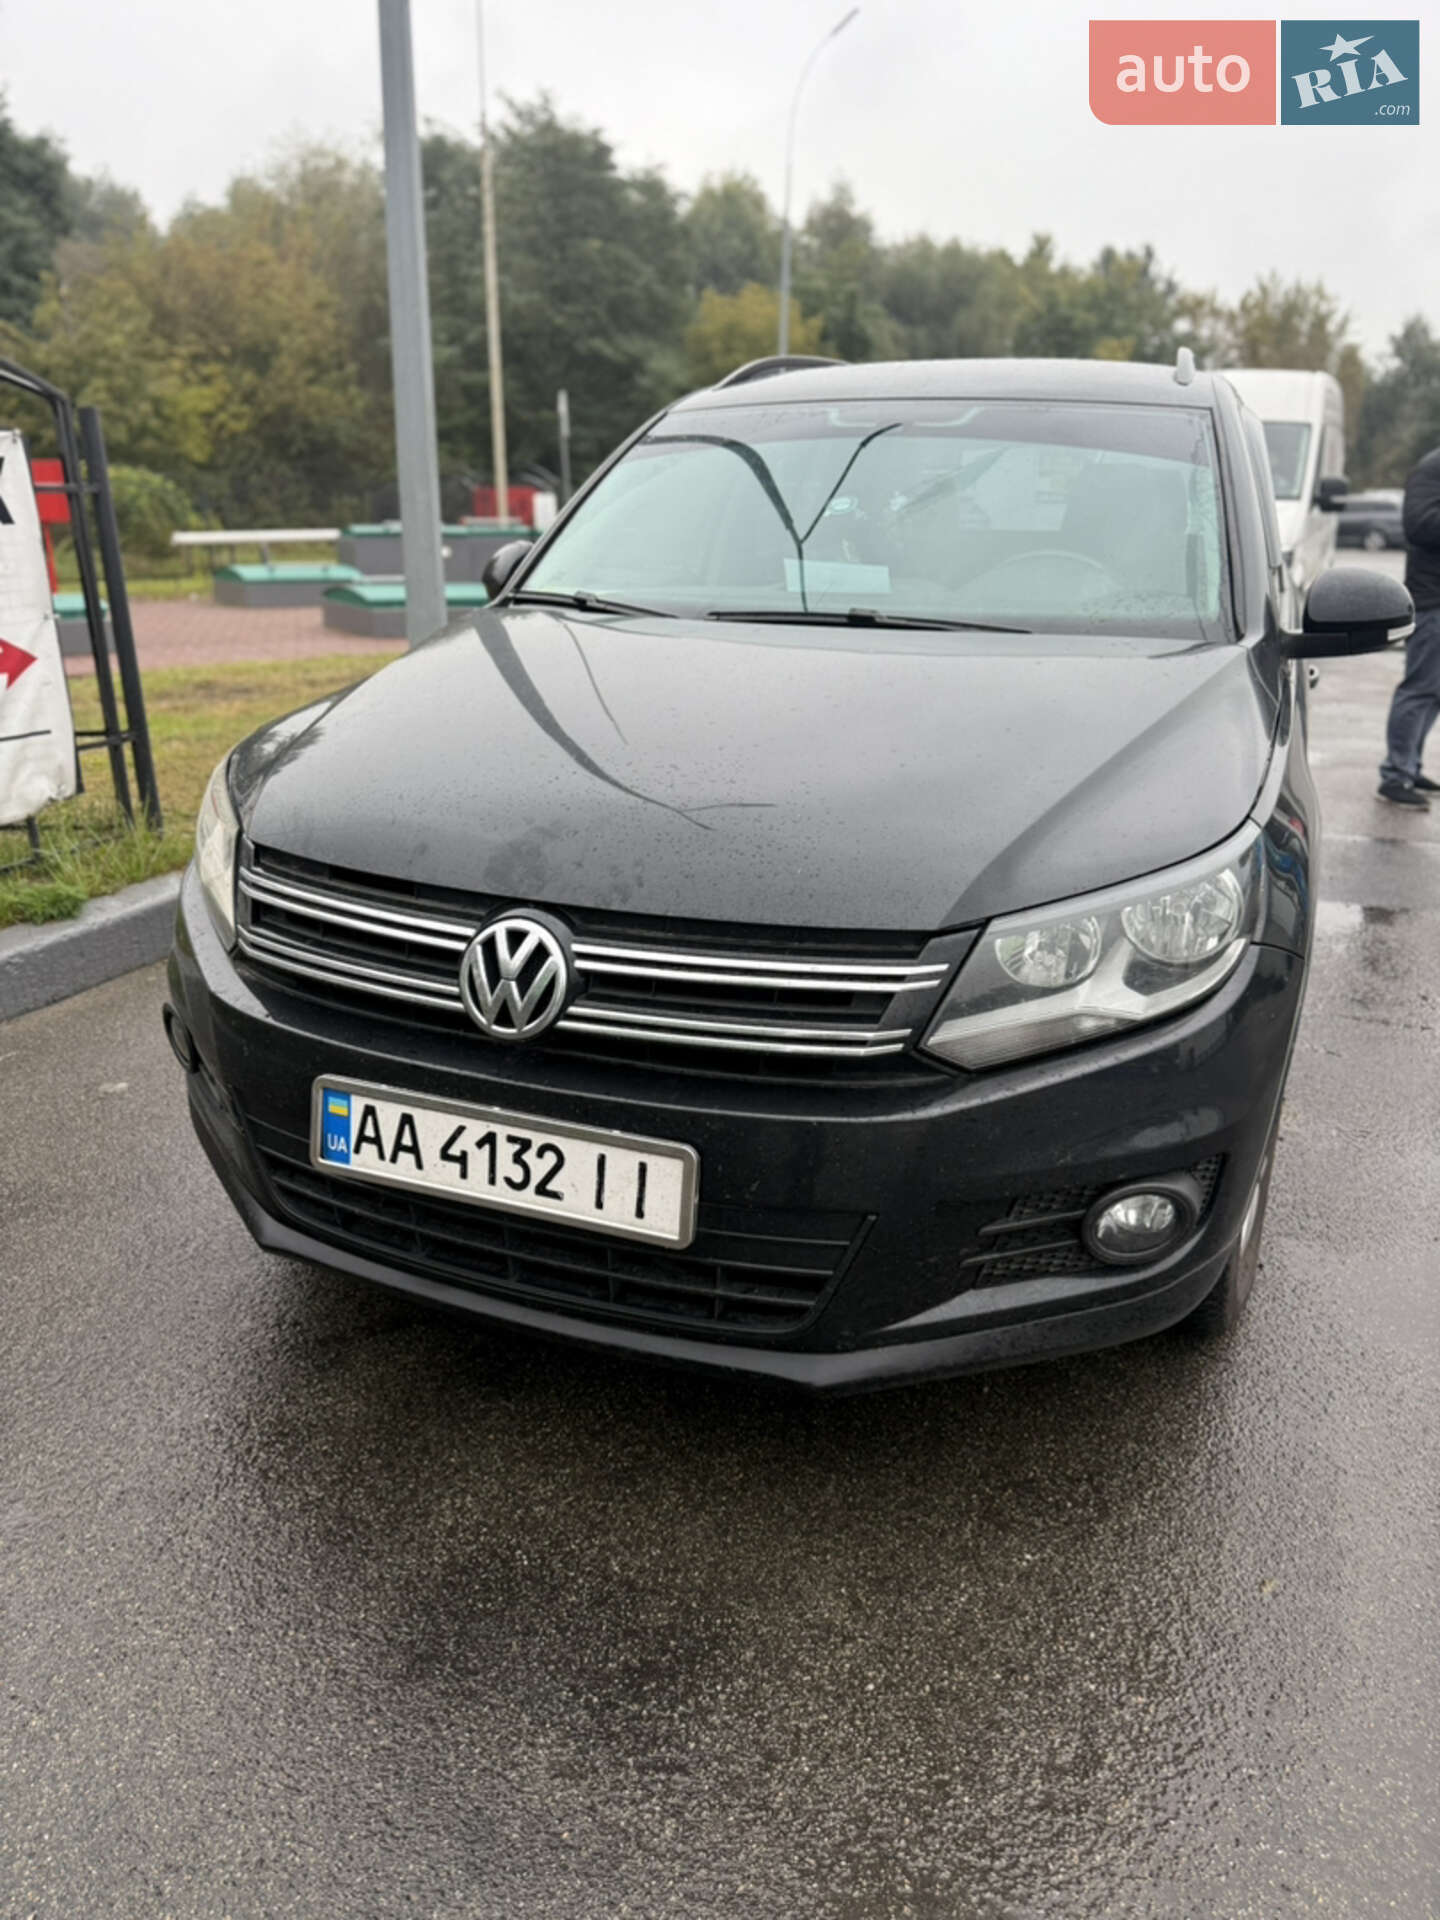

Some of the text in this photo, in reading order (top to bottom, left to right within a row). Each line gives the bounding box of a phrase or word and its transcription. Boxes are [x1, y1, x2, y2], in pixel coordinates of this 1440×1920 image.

[327, 1133, 348, 1153] UA
[353, 1103, 424, 1171] AA
[440, 1125, 565, 1201] 4132
